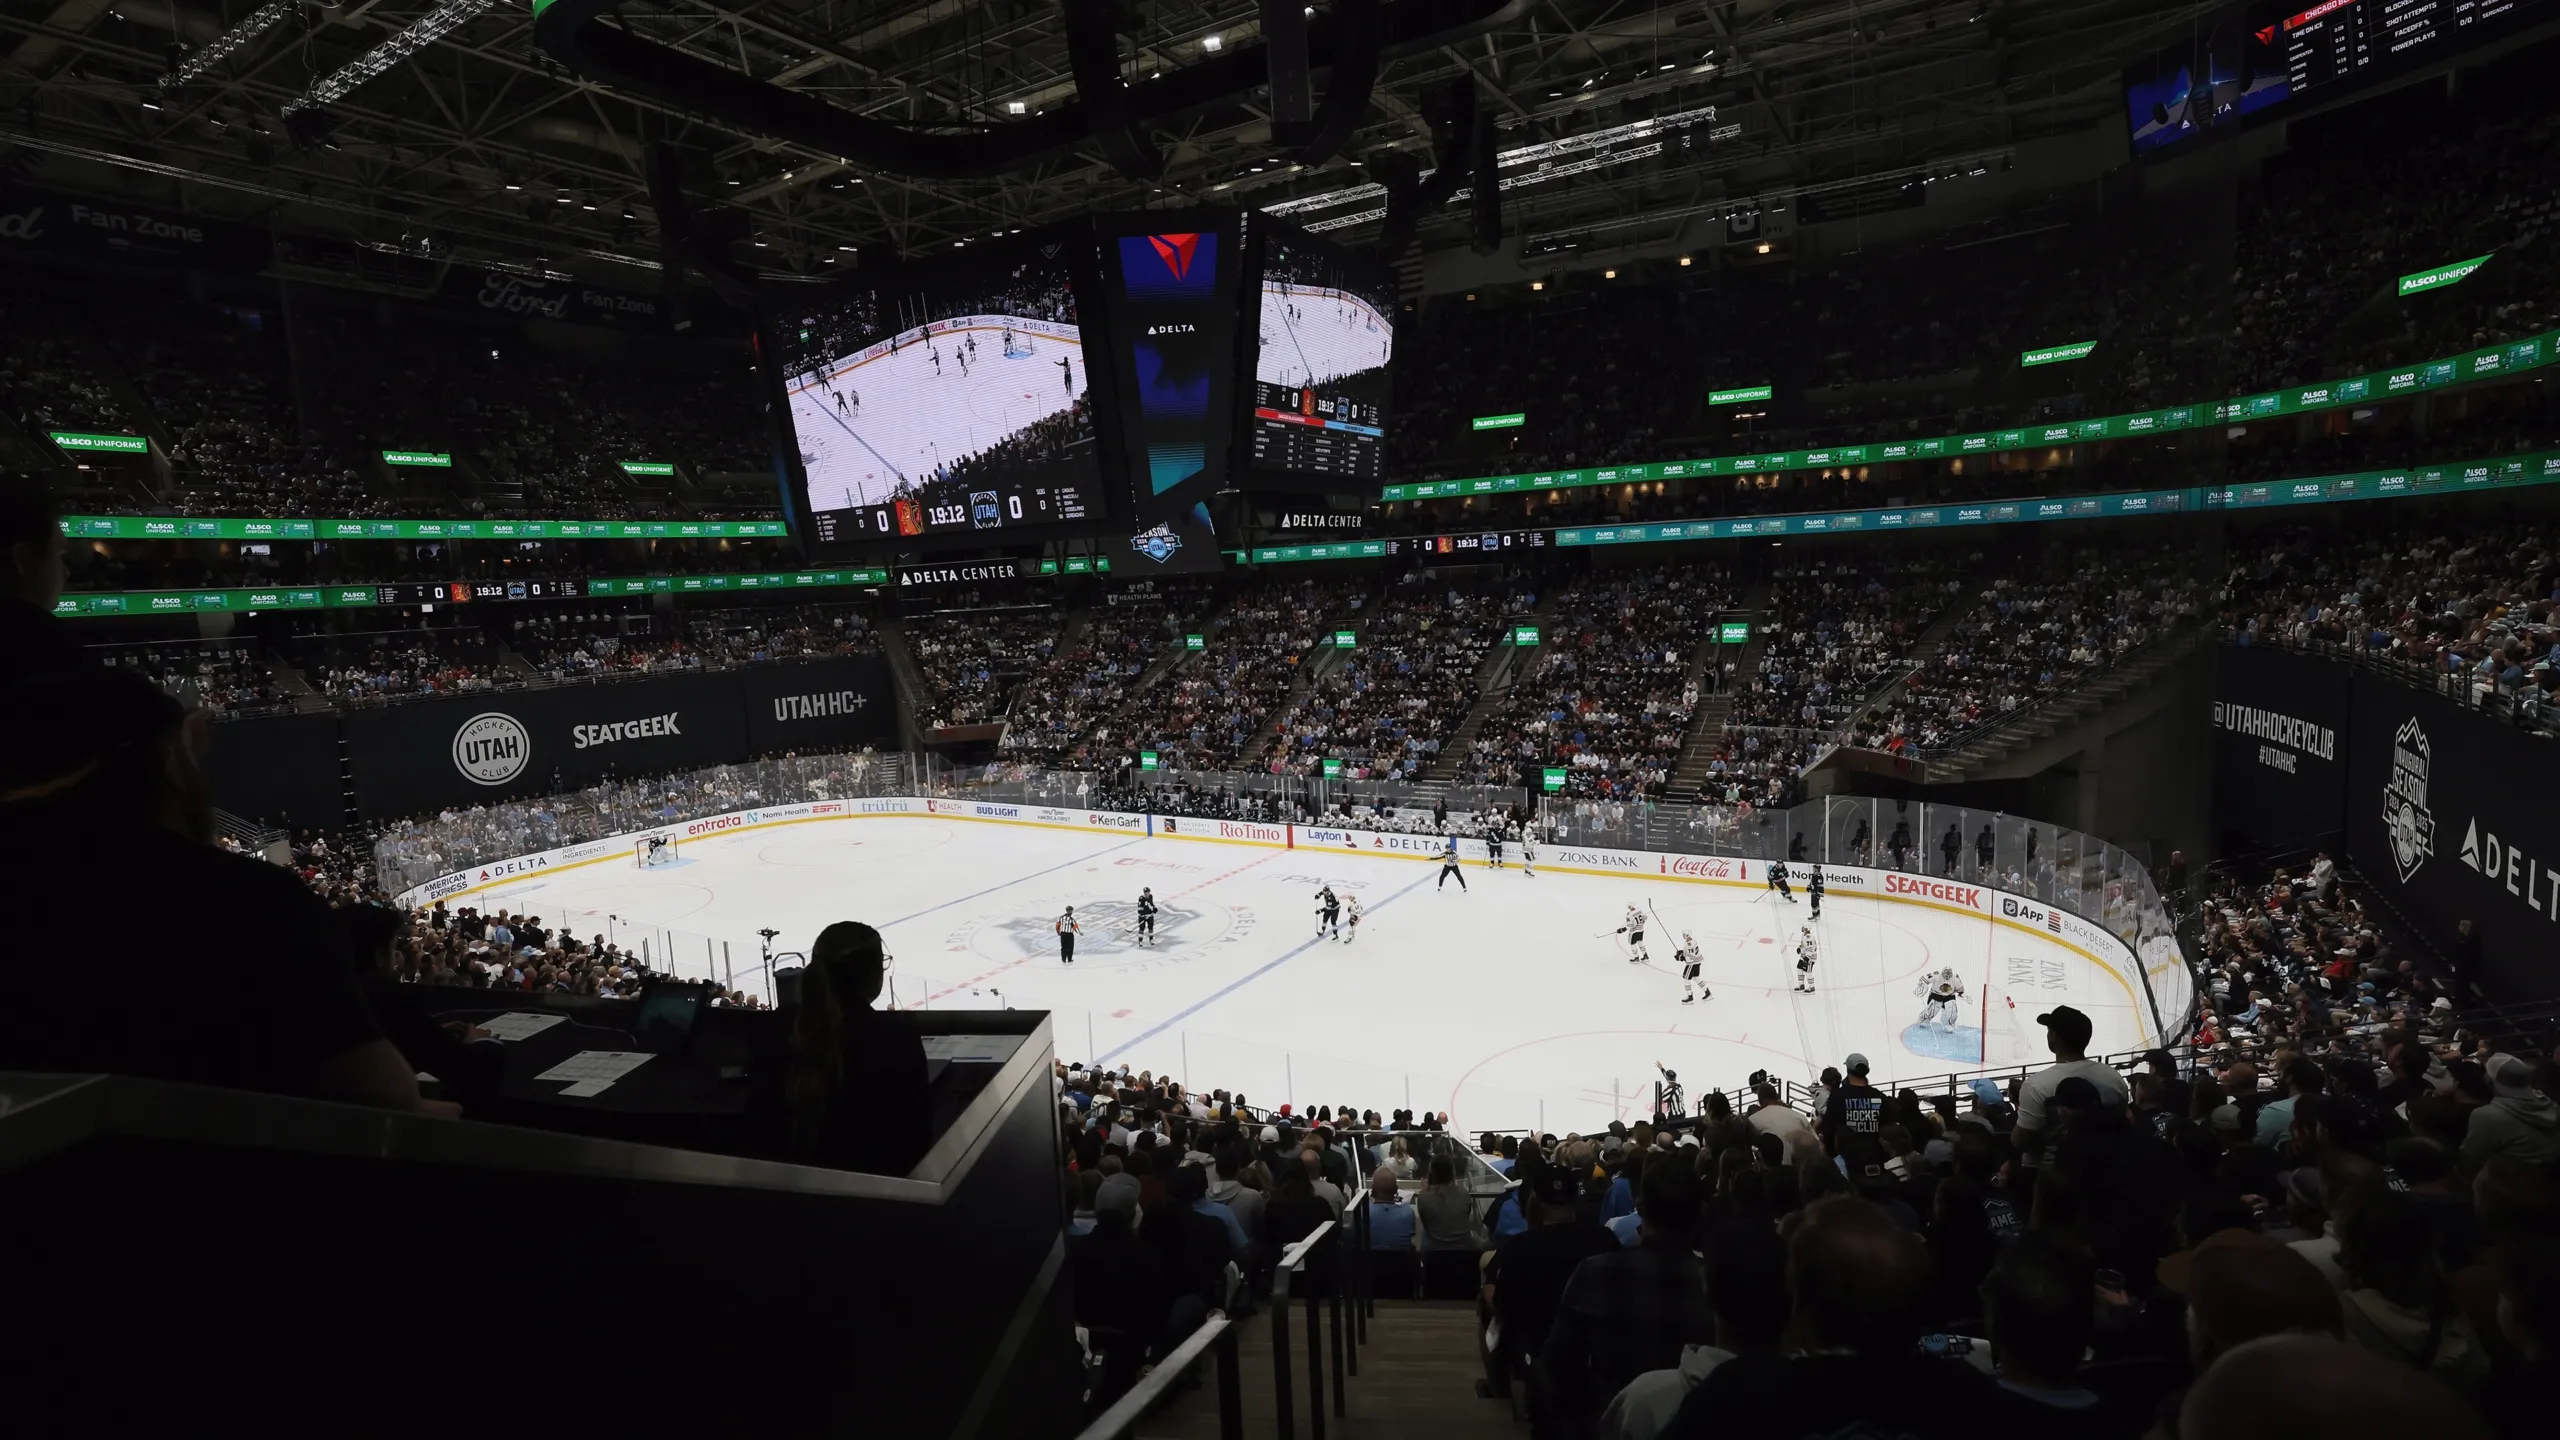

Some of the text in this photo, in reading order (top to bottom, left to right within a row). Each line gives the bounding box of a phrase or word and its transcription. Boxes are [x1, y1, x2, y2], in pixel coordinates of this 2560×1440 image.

[2456, 2, 2475, 13] 100%
[2386, 2, 2437, 28] SHOT ATTEMPTS
[2460, 16, 2473, 27] 0/0
[2292, 29, 2305, 40] TIME
[2305, 25, 2314, 36] ON
[2314, 21, 2324, 31] ICE
[2395, 22, 2423, 37] FACEOFF
[2391, 30, 2436, 53] POWER PLAYS
[2358, 57, 2369, 66] 0/0
[71, 204, 128, 231] Fan
[134, 214, 204, 243] Zone
[2402, 264, 2479, 290] ALSCO UNIFOR
[582, 290, 614, 310] Fan
[617, 296, 656, 315] Zone
[1027, 321, 1050, 333] DELTA
[1159, 324, 1195, 334] DELTA
[2025, 352, 2053, 362] ALSCO
[2474, 354, 2499, 366] ALSCO
[2389, 373, 2415, 384] ALSCO
[1292, 392, 1299, 408] 0
[1711, 391, 1769, 401] ALSCO UNIFORMS
[2301, 389, 2328, 400] ALSCO
[1318, 399, 1335, 413] 19:12
[1352, 404, 1358, 419] 0
[1475, 419, 1495, 427] ALSCO
[2129, 417, 2153, 426] ALSCO
[2045, 428, 2068, 436] ALSCO
[56, 437, 143, 449] ALSCO UNIFORMS
[386, 454, 412, 462] ALSCO
[1734, 459, 1756, 467] ALSCO
[2464, 467, 2488, 478] ALSCO
[2380, 476, 2405, 485] ALSCO
[2293, 484, 2319, 493] ALSCO
[974, 503, 998, 520] UTAH
[1009, 495, 1023, 519] 0
[1040, 500, 1046, 510] 0
[876, 510, 889, 532] 0
[928, 504, 966, 525] 19:12
[1293, 514, 1362, 528] DELTA CENTER
[858, 519, 865, 529] 0
[1425, 540, 1432, 550] 0
[1456, 538, 1478, 549] 19:12
[1483, 538, 1498, 547] UTAH
[1504, 536, 1511, 546] 0
[914, 565, 1015, 585] DELTA CENTER
[435, 587, 444, 599] 0
[476, 586, 503, 596] 19:12
[509, 587, 525, 595] UTAH
[532, 584, 541, 595] 0
[152, 598, 181, 606] ALSCO
[774, 690, 868, 722] UTAH HC+
[470, 720, 513, 738] HOCKEY
[572, 712, 681, 749] SEATGEEK
[2213, 701, 2334, 761] @UTAHHOCKEYCLUB
[465, 736, 519, 765] UTAH
[2258, 744, 2297, 775] #UTAHHC
[481, 764, 511, 777] CLUB
[2394, 765, 2425, 810] SEASON
[812, 803, 842, 814] ESPN
[861, 799, 908, 812] trüfrü
[938, 802, 962, 811] HEALTH
[976, 806, 1019, 818] BUD LIGHT
[762, 807, 809, 819] Nomi Health
[1037, 814, 1071, 823] AMERICA FIRST
[688, 815, 742, 835] entrata
[1098, 815, 1141, 828] Ken Garff
[1308, 829, 1342, 842] Layton
[2400, 821, 2414, 850] UTAH
[1390, 838, 1442, 852] DELTA
[562, 845, 606, 860] INGREDIENTS
[1559, 851, 1639, 868] ZIONS BANK
[494, 856, 547, 878] DELTA
[1672, 855, 1732, 878] Coca-Cola
[423, 872, 467, 894] AMERICAN
[1826, 873, 1864, 885] Health
[2485, 832, 2560, 922] DELT
[430, 881, 469, 900] EXPRESS
[1885, 874, 1981, 909] SEATGEEK
[2064, 920, 2089, 939] BLACK
[2089, 930, 2114, 954] DESERT
[2008, 957, 2034, 987] BANK
[2040, 959, 2068, 990] ZIONS
[1845, 1098, 1871, 1110] UTAH
[2387, 1178, 2411, 1193] ME
[1990, 1212, 2016, 1229] AME
